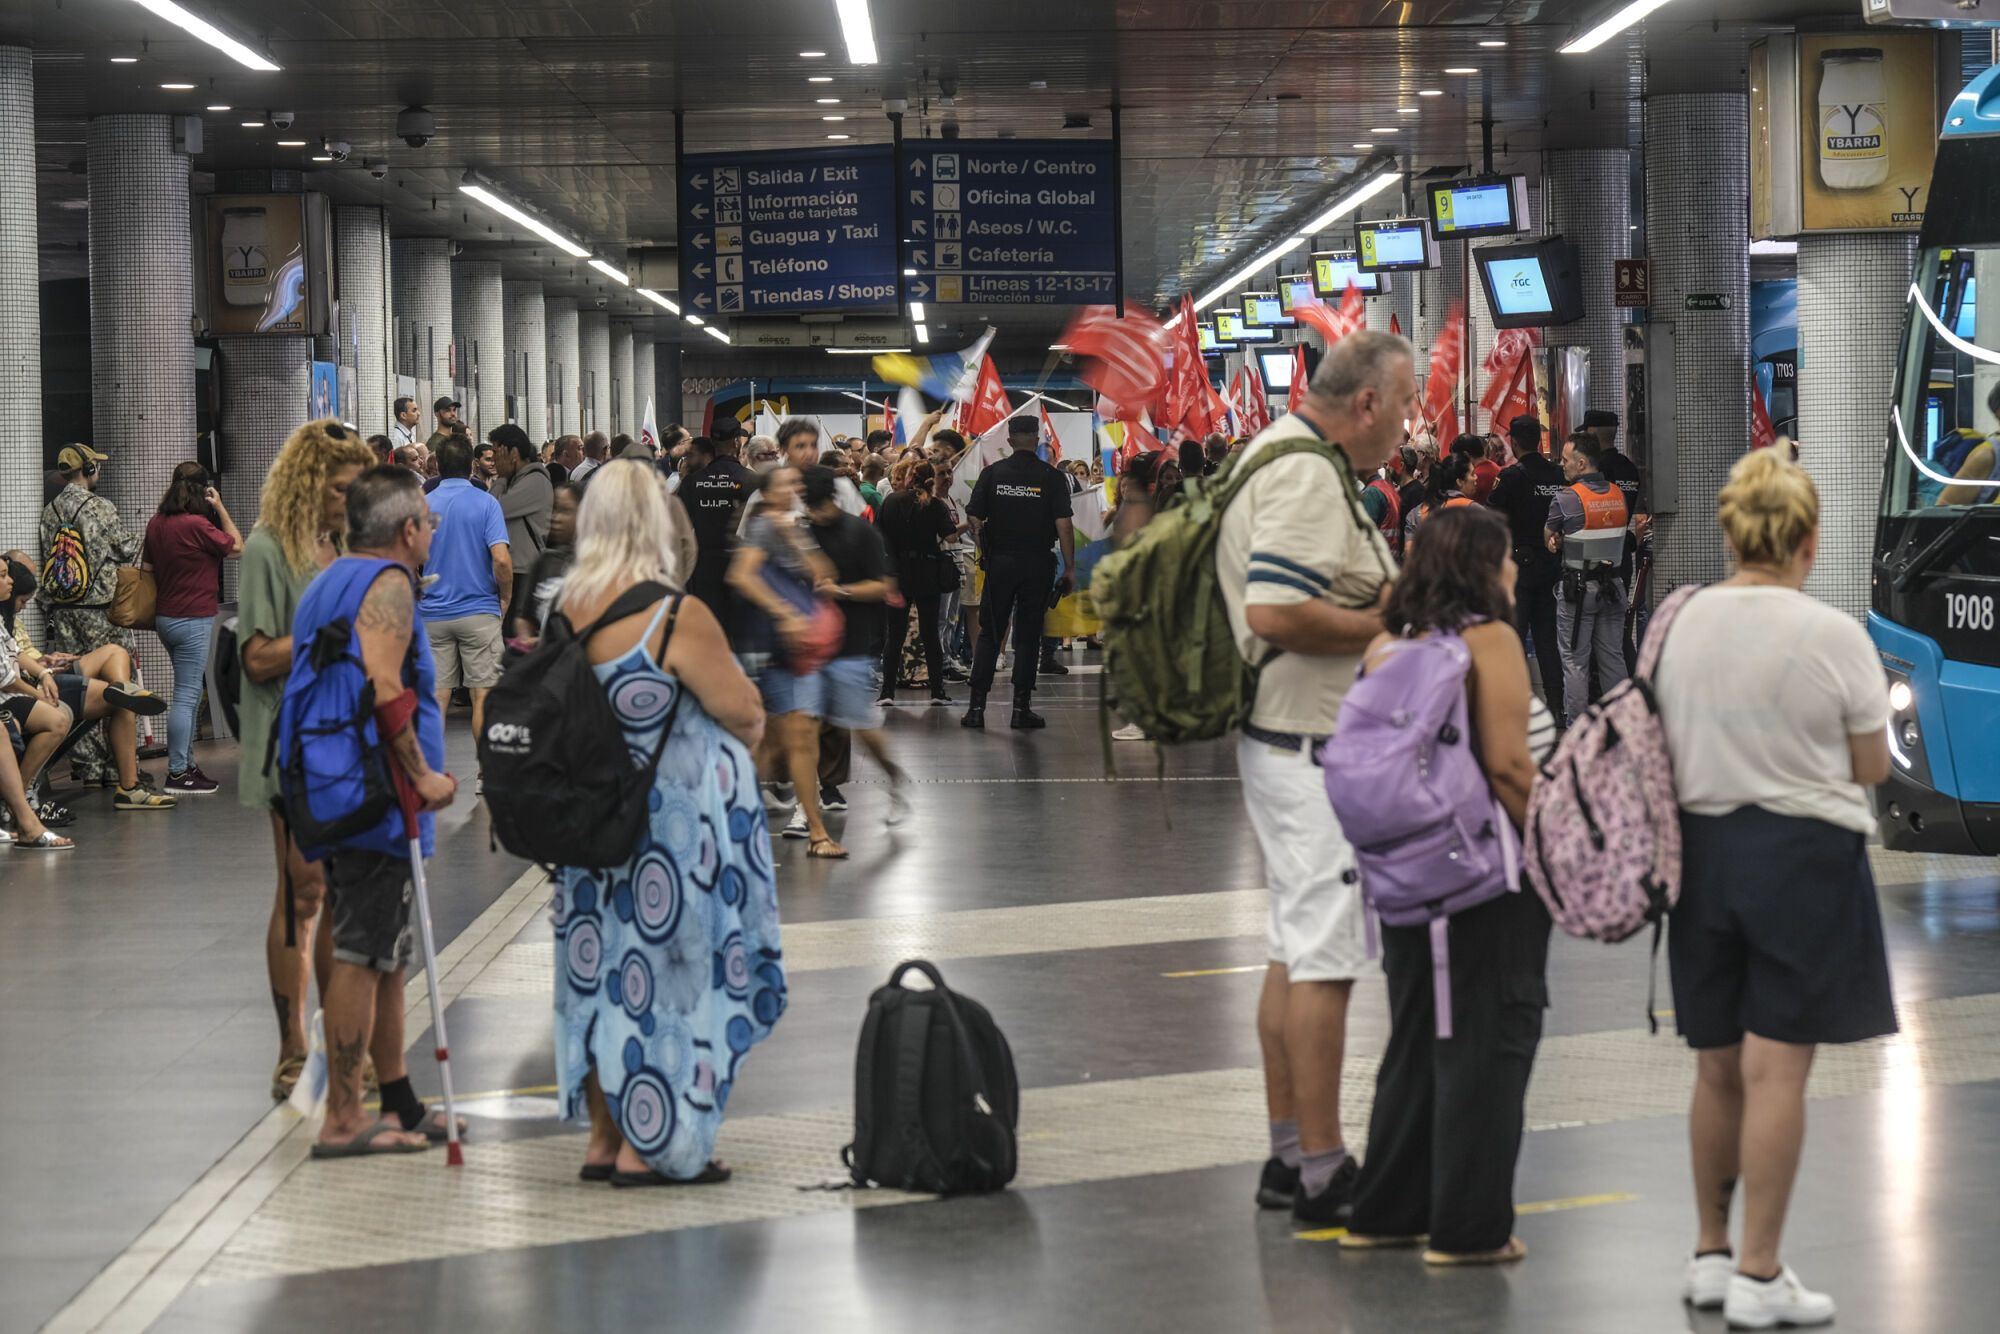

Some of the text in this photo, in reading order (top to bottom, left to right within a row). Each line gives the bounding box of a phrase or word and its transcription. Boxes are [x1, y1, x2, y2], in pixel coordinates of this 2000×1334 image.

[1829, 137, 1879, 148] YBARRA
[967, 159, 1097, 175] Norte / Centro
[747, 166, 859, 186] Salida / Exit
[748, 190, 858, 209] Información
[967, 189, 1095, 205] Oficina Global
[1440, 196, 1449, 212] 9
[748, 206, 858, 222] Venta de tarjetas
[750, 223, 879, 246] Guagua y Taxi
[967, 219, 1078, 235] Aseos / W.C.
[1365, 235, 1372, 249] 8
[968, 247, 1054, 263] Cafetería
[230, 269, 266, 278] YBARRA
[749, 257, 829, 275] Teléfono
[1320, 264, 1327, 277] 7
[969, 276, 1113, 291] Líneas 12-13-17
[1513, 278, 1531, 287] TGC
[750, 283, 896, 304] Tiendas / Shops
[970, 291, 1056, 303] Dirección sur
[1284, 286, 1290, 298] 6
[1248, 303, 1255, 313] 5
[1221, 320, 1228, 328] 4
[1776, 363, 1794, 378] 1703
[695, 481, 737, 489] POLICIA
[996, 484, 1033, 492] POLICIA
[996, 489, 1041, 498] NACIONAL
[700, 499, 732, 508] U.I.P.
[1945, 592, 1995, 631] 1908
